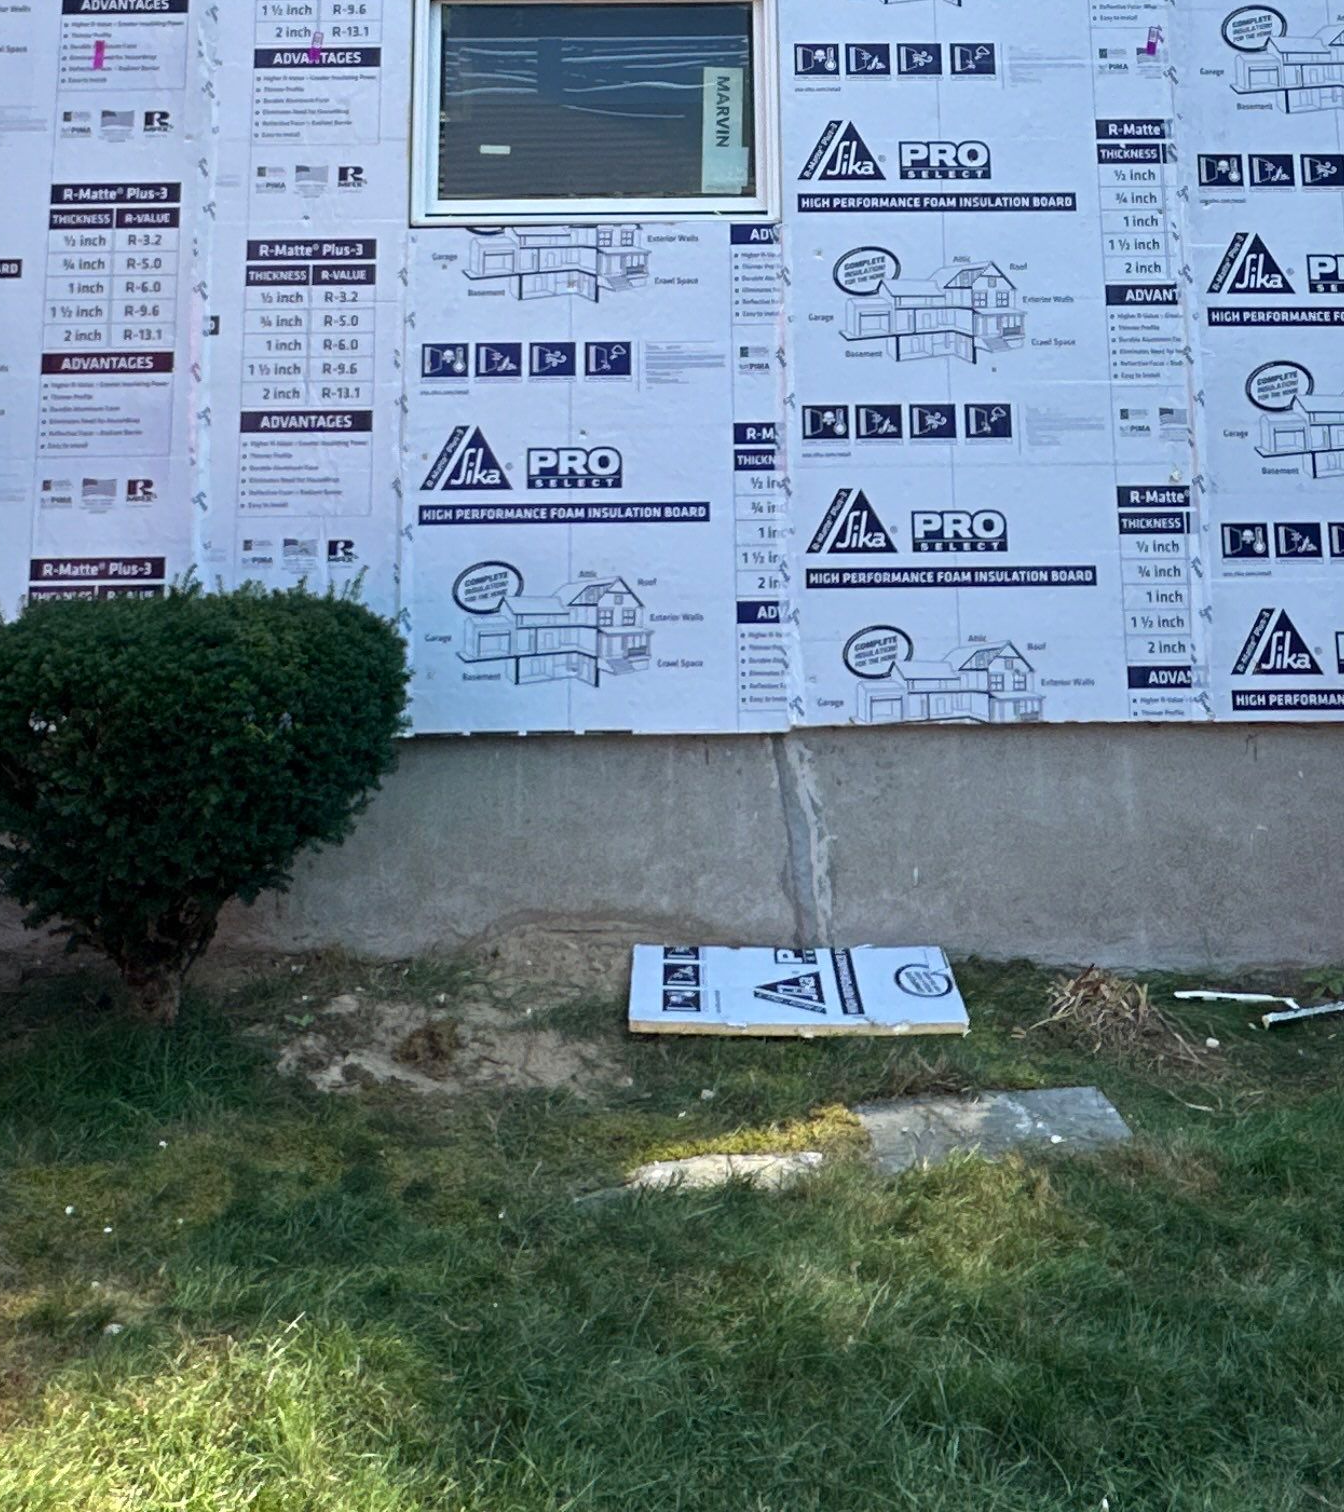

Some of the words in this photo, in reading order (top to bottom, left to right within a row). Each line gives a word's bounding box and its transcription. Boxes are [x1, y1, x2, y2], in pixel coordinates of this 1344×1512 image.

[715, 76, 730, 148] MARVIN
[827, 141, 875, 175] Sika
[901, 143, 988, 167] PRO
[908, 170, 983, 178] SELECT
[321, 243, 363, 256] Plus-3
[844, 256, 886, 271] COMPLETE
[248, 269, 307, 282] THICKNESS
[320, 269, 366, 280] R-VALUE
[808, 313, 834, 322] Garage
[1053, 338, 1076, 347] Space
[845, 350, 883, 358] Basement
[260, 414, 352, 428] ADVANTAGES
[448, 448, 501, 485] Sika
[530, 449, 620, 475] PRO
[535, 479, 613, 487] SELECT
[422, 509, 453, 520] HIGH
[455, 507, 547, 520] PERFORMANCE
[549, 507, 585, 519] FOAM
[587, 506, 661, 519] INSULATION
[664, 505, 706, 518] BOARD
[836, 510, 886, 548] Sika
[914, 512, 1004, 538] PRO
[921, 540, 999, 551] SELECT
[809, 572, 839, 584] HIGH
[842, 571, 934, 584] PERFORMANCE
[936, 571, 972, 583] FOAM
[974, 570, 1048, 582] INSULATION
[1051, 569, 1093, 582] BOARD
[1261, 631, 1311, 669] Sika
[1235, 694, 1266, 706] HIGH
